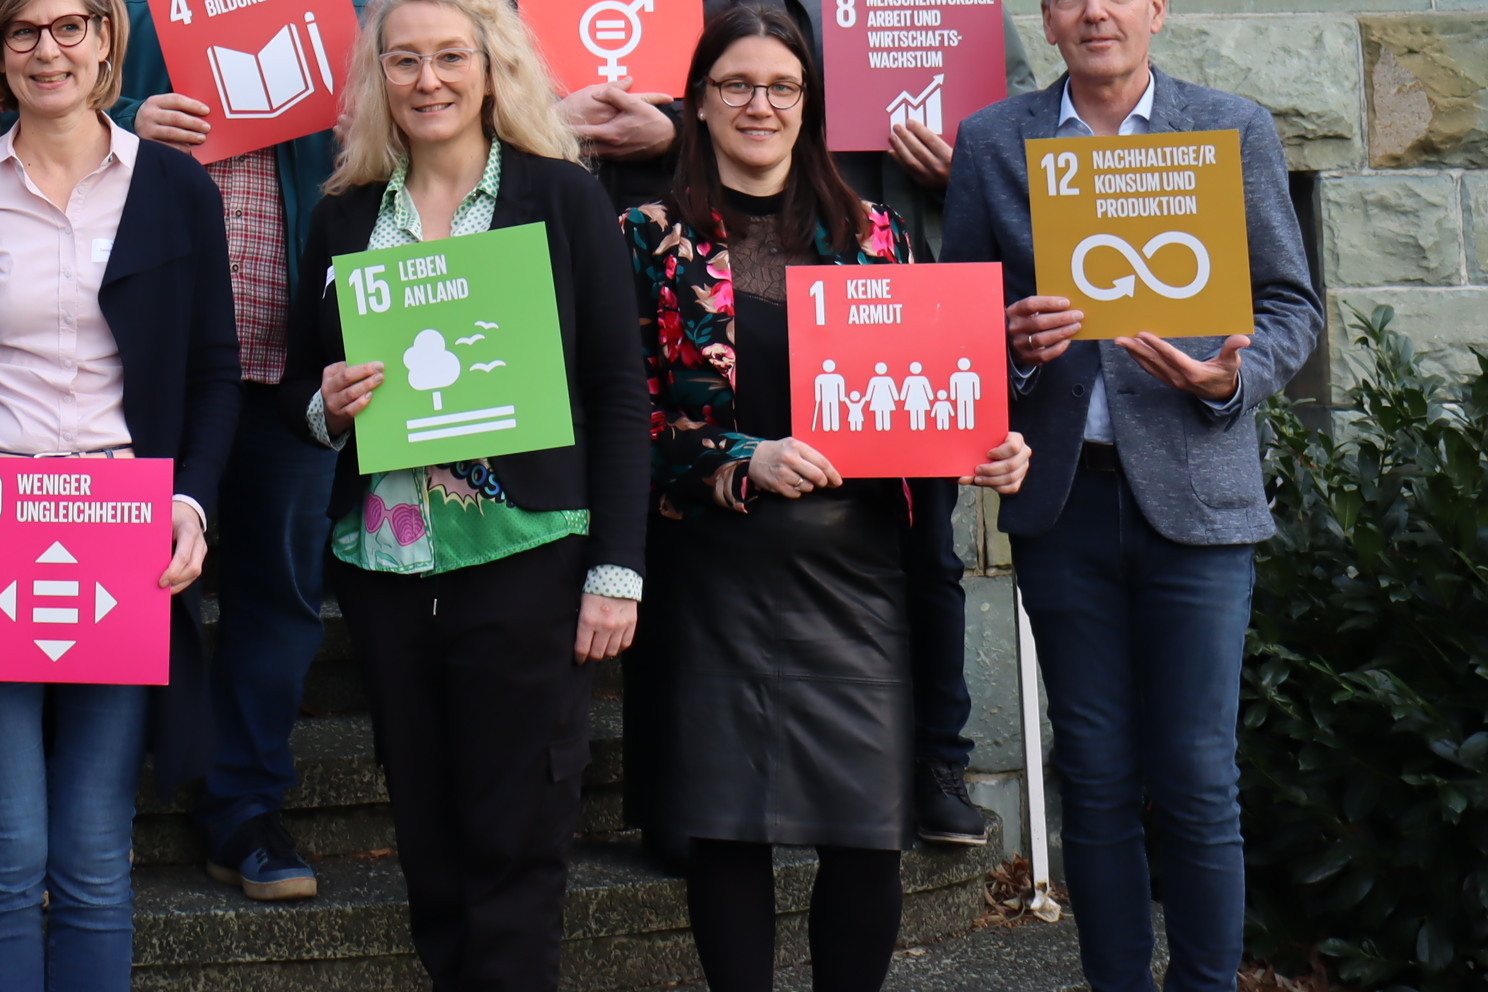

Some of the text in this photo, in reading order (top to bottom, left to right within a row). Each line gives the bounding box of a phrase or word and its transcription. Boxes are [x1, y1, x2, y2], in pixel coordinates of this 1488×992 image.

[867, 9, 941, 28] ARBEIT UND
[867, 30, 962, 48] WIRTSCHAFTS-
[868, 51, 943, 69] WACHSTUM
[1092, 144, 1216, 170] NACHHALTIGE/R
[1041, 151, 1080, 196] 12
[1094, 171, 1196, 194] KONSUM UND
[1096, 195, 1197, 218] PRODUKTION
[398, 254, 447, 282] LEBEN
[348, 264, 392, 316] 15
[404, 277, 469, 308] AN LAND
[846, 278, 892, 299] KEINE
[809, 280, 826, 326] 1
[848, 304, 903, 325] ARMUT
[16, 473, 92, 496] WENIGER
[16, 501, 152, 524] UNGLEICHHEITEN
